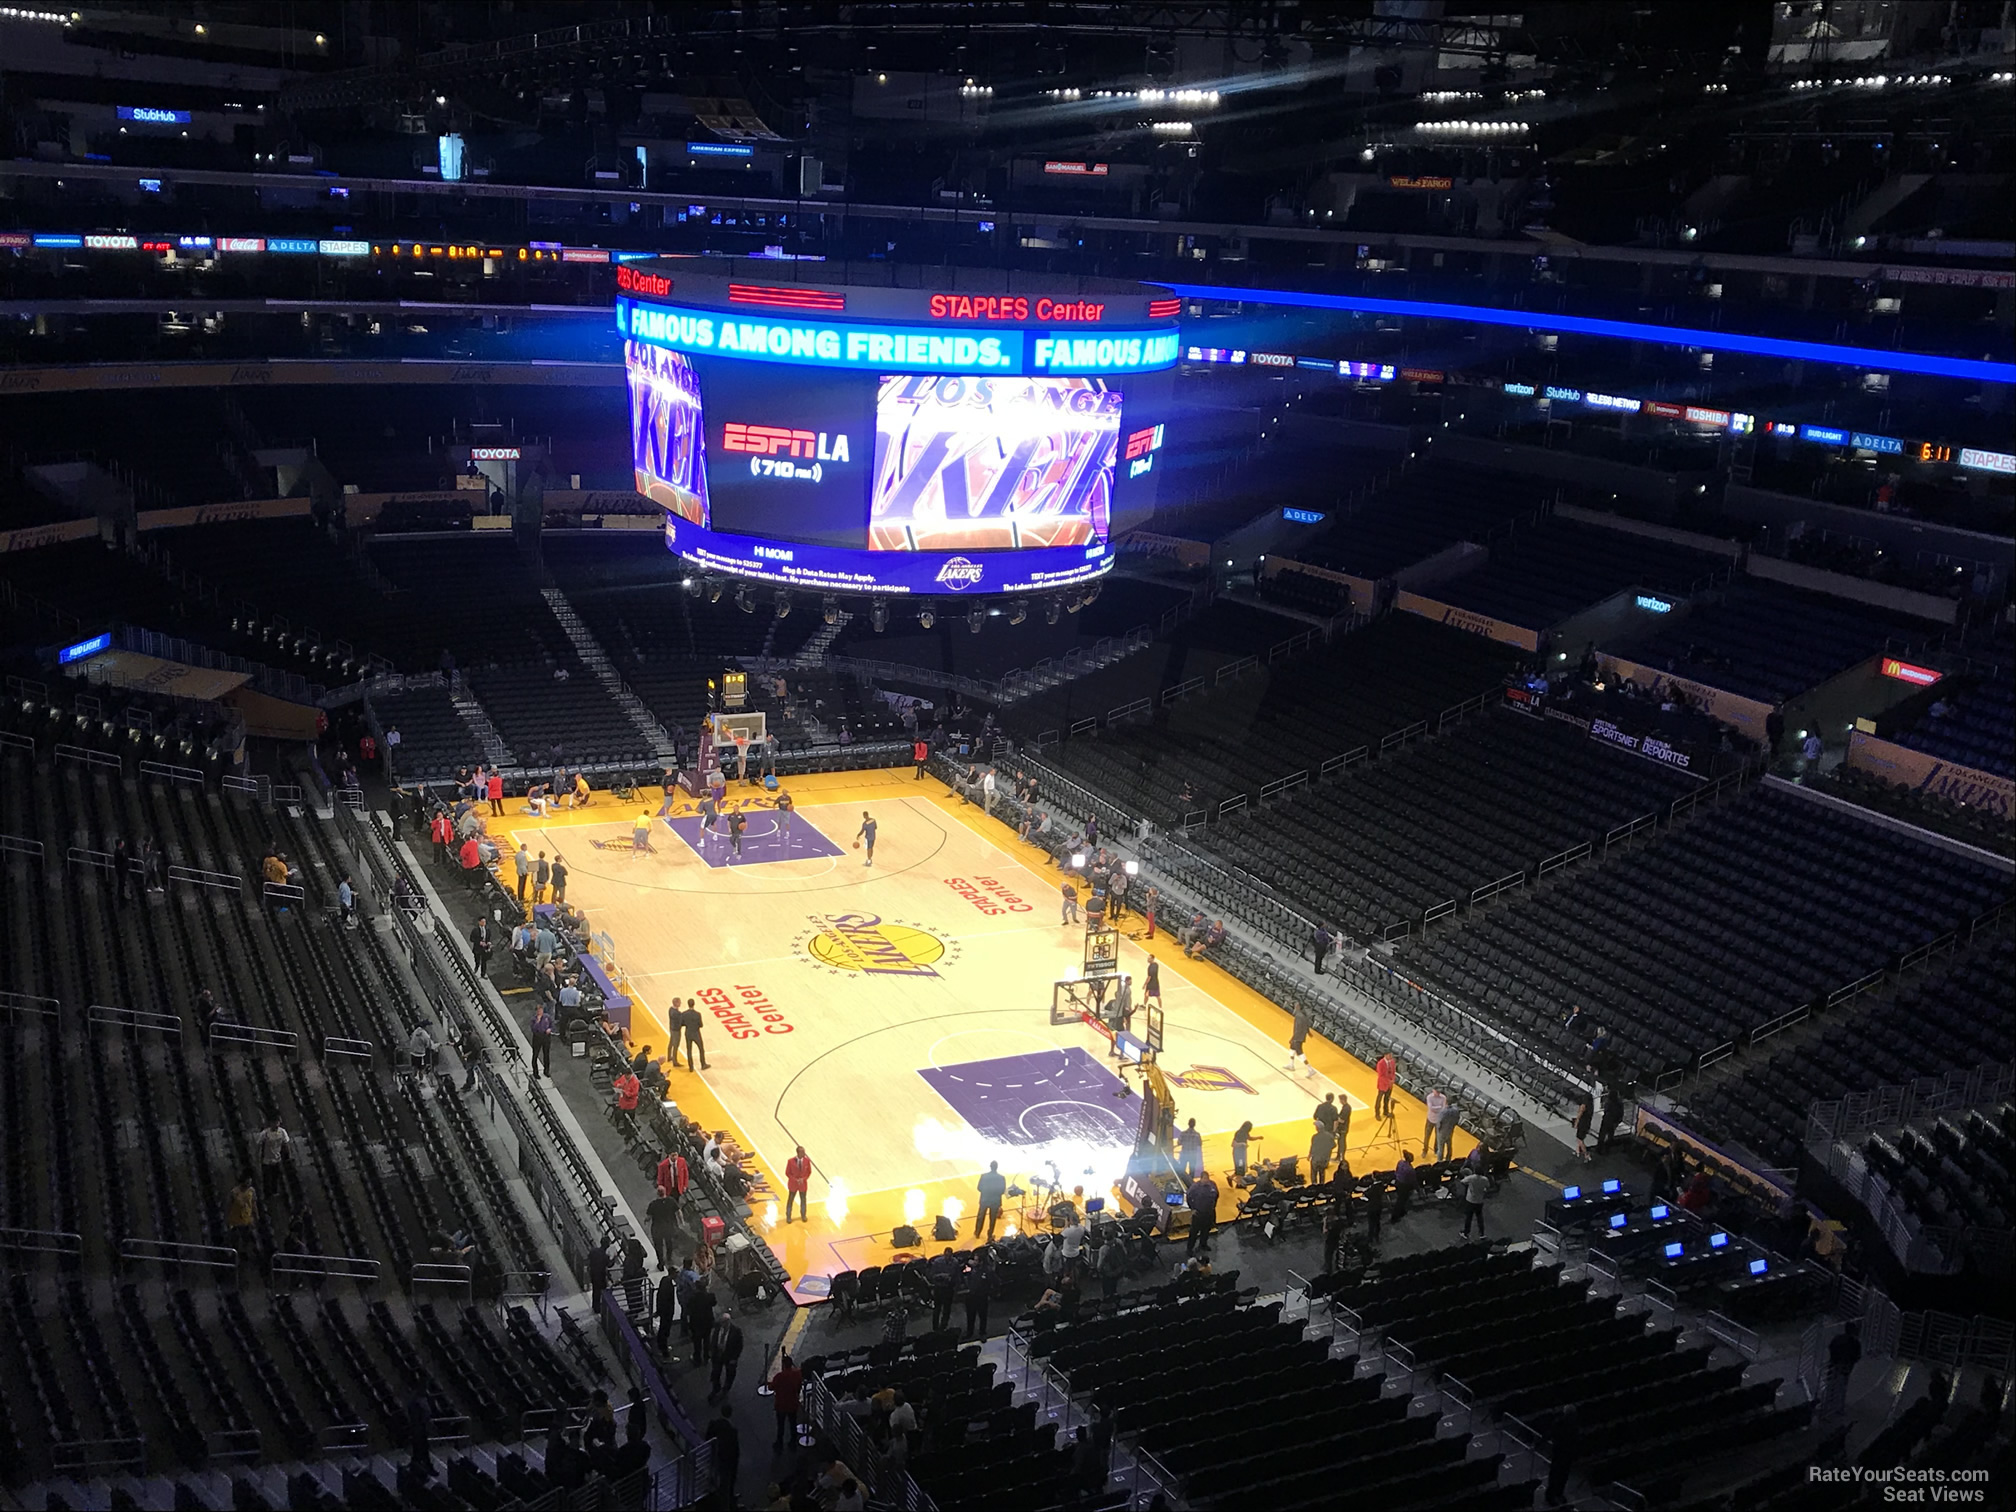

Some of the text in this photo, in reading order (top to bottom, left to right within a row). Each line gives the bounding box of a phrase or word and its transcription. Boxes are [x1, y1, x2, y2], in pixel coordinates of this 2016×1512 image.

[133, 108, 176, 122] StubHub
[1392, 178, 1451, 188] WELLS FARGO
[85, 235, 138, 248] TOYOTA
[281, 242, 316, 250] DELTA
[319, 241, 367, 254] STAPLES
[633, 270, 671, 296] Center
[931, 295, 1105, 321] STAPLES Center
[632, 307, 715, 347] FAMOUS
[719, 322, 841, 359] AMONG
[846, 332, 1011, 368] FRIENDS.
[1034, 337, 1141, 367] FAMOUS
[1252, 353, 1294, 366] TOYOTA
[1505, 383, 1534, 395] verizon
[1547, 387, 1580, 401] StubHub
[1687, 408, 1728, 424] TOSHIBA
[724, 423, 850, 462] ESPN LA
[1808, 429, 1842, 441] BUD LIGHT
[1865, 437, 1901, 451] DELTA
[472, 448, 520, 459] TOYOTA
[1921, 442, 1950, 461] 6:11
[1963, 449, 2016, 471] STAPLES
[761, 460, 795, 477] 710
[754, 545, 764, 557] HI
[803, 568, 818, 577] Data
[819, 569, 837, 579] Rates
[838, 572, 853, 582] May
[853, 573, 876, 583] Apply.
[935, 564, 984, 583] LAKERS
[789, 575, 799, 583] No
[799, 578, 829, 587] purchase
[830, 581, 864, 591] necessary
[872, 584, 910, 593] participate
[1003, 583, 1014, 591] The
[1637, 595, 1671, 613] verizon
[70, 638, 101, 658] BUD LIGHT
[1530, 695, 1540, 707] LA
[1591, 724, 1640, 749] SPORTSNET
[1642, 742, 1691, 768] DEPORTES
[943, 877, 1007, 916] STAPLES
[972, 875, 1034, 912] Center
[824, 908, 946, 982] LAKERS
[695, 987, 761, 1040] STAPLES
[733, 984, 795, 1035] Center
